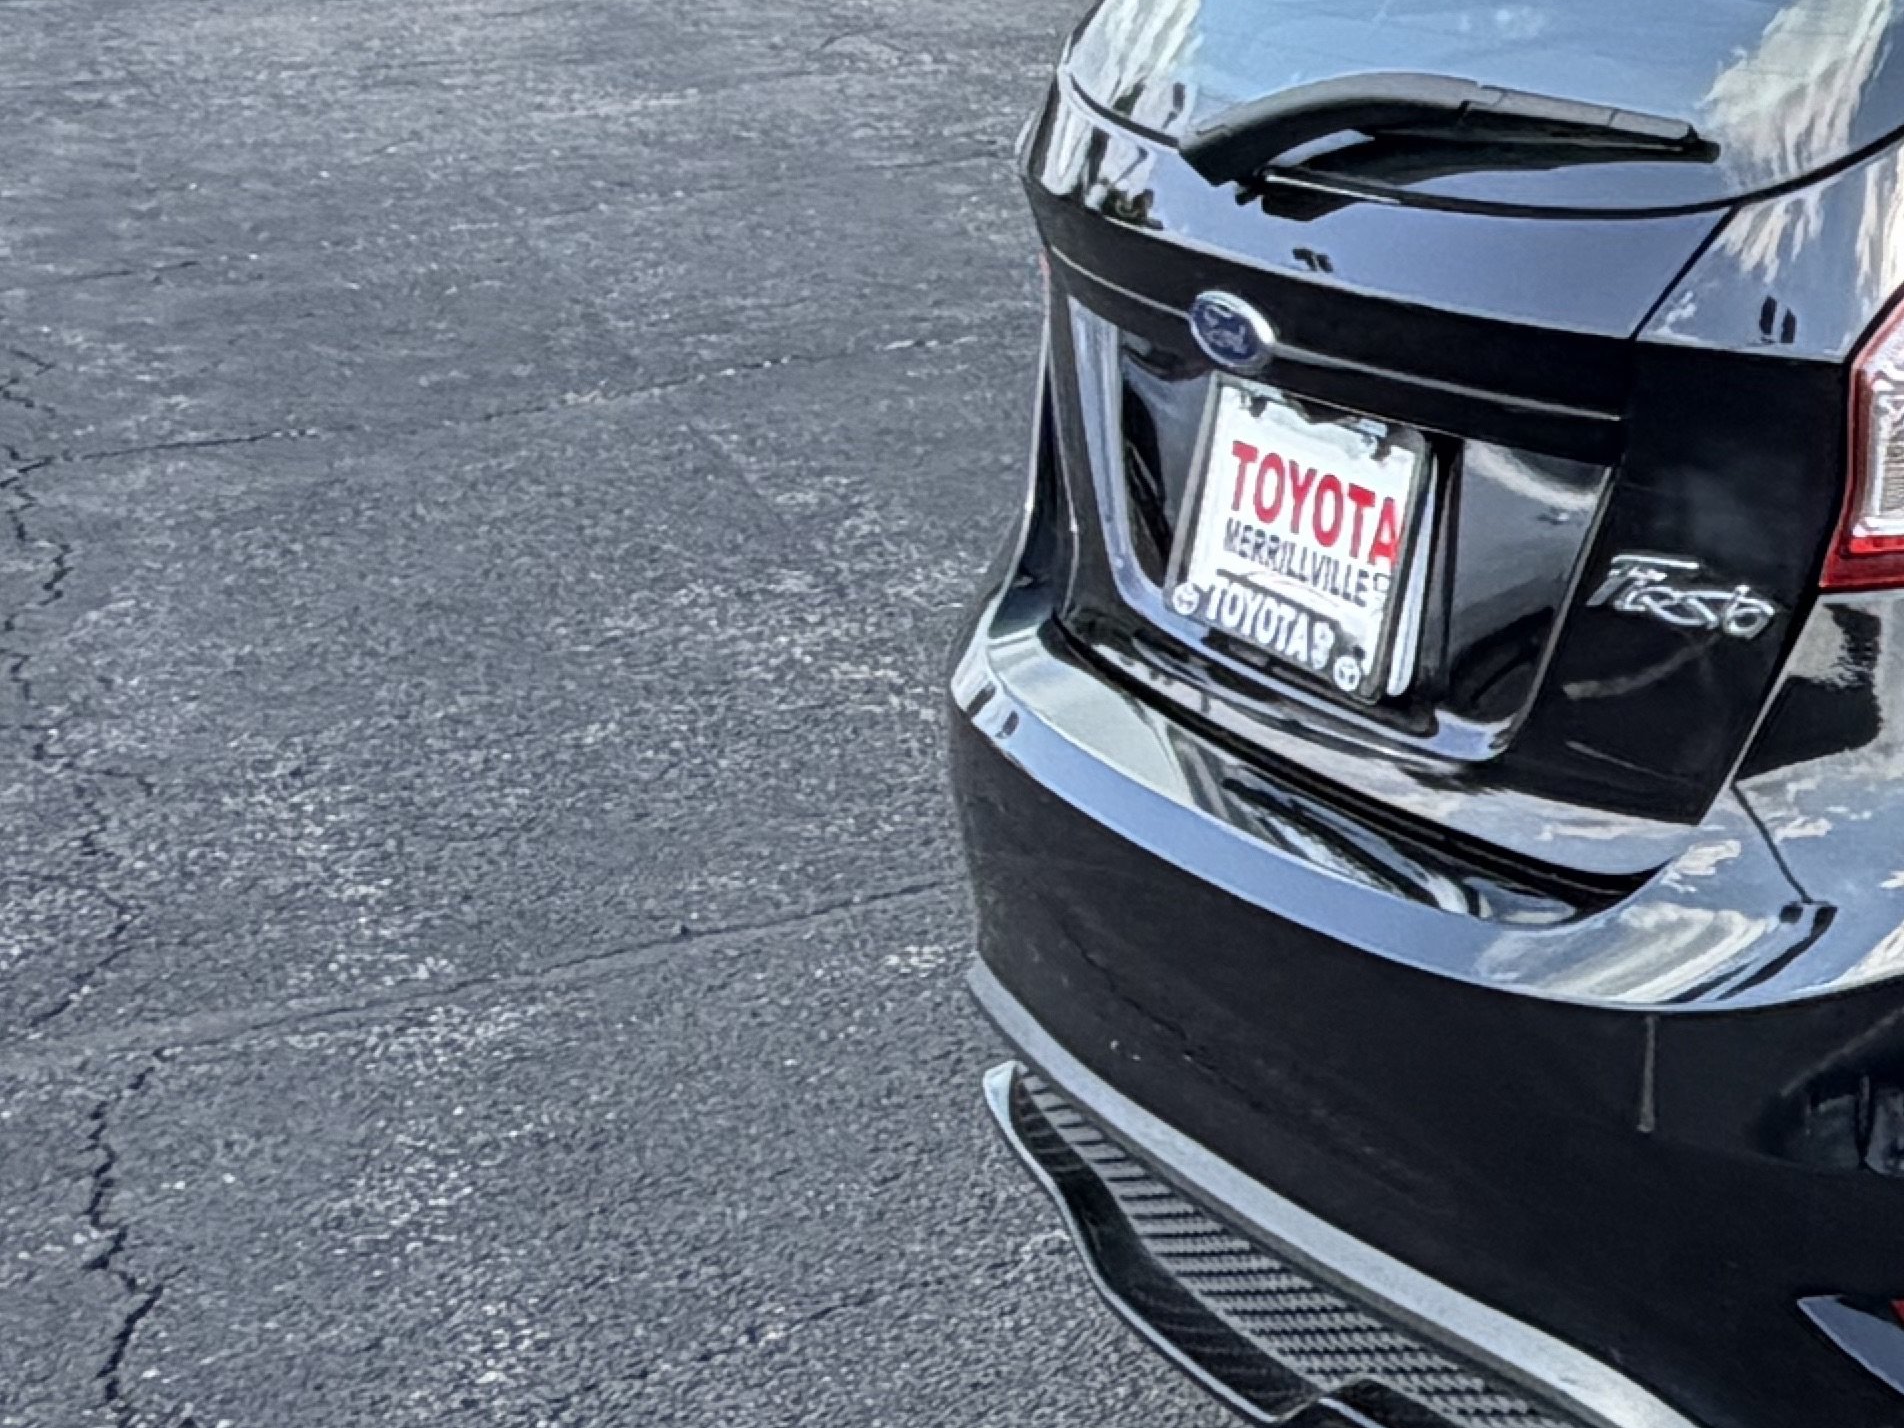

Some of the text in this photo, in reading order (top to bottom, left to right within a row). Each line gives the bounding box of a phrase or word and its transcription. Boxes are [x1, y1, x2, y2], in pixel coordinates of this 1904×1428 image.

[1230, 440, 1399, 567] TOYOTA
[1223, 516, 1370, 608] MERRILLVILLE
[1586, 553, 1775, 640] Fiesta
[1205, 581, 1309, 663] TOYOTA
